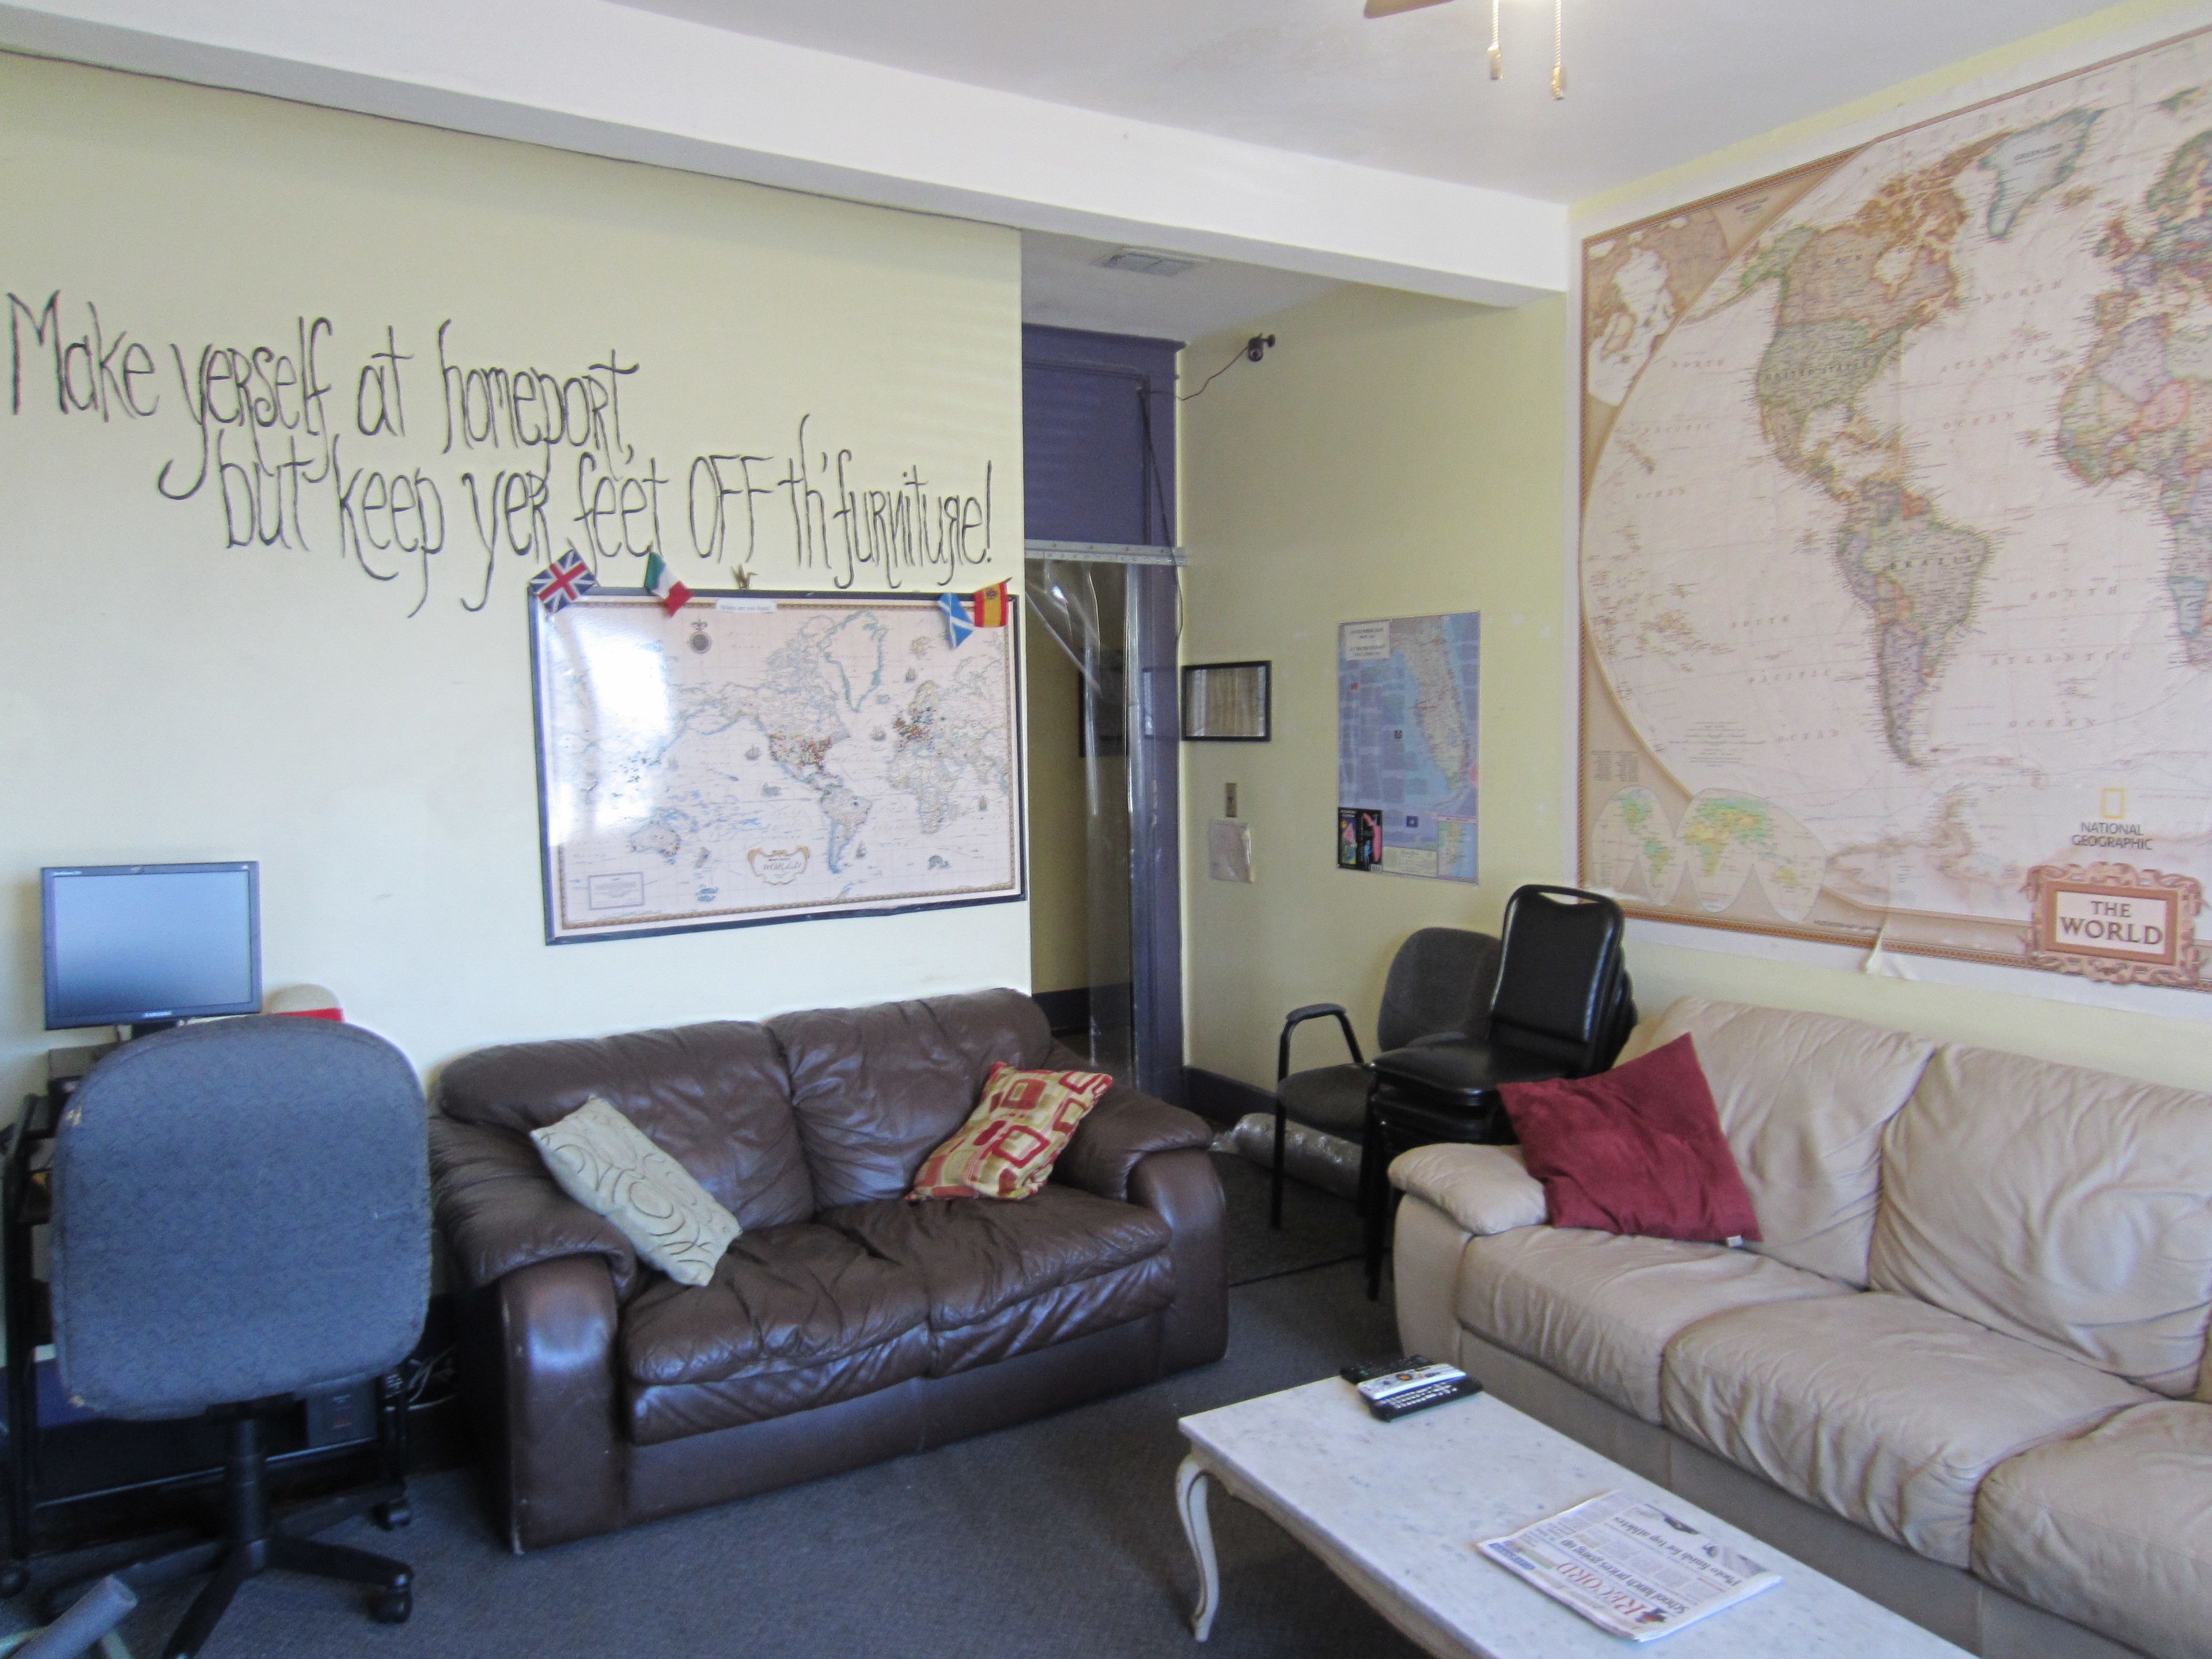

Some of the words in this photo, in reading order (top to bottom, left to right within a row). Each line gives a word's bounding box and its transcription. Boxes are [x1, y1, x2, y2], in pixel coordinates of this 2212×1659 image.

[7, 290, 159, 422] Make
[358, 326, 414, 437] at
[218, 429, 314, 551] but
[333, 433, 446, 619] keep
[574, 452, 669, 588] feet
[691, 456, 773, 564] OFF
[2080, 821, 2143, 836] NATIONAL
[2073, 835, 2153, 850] GEOGRAPHIC
[2091, 900, 2131, 918] THE
[2059, 916, 2163, 945] WORLD
[1613, 1517, 1651, 1537] athletes
[1680, 1552, 1711, 1570] finish
[1599, 1562, 1631, 1581] prices
[1710, 1567, 1740, 1586] Photo
[1626, 1581, 1656, 1596] lunch
[1651, 1593, 1686, 1612] School
